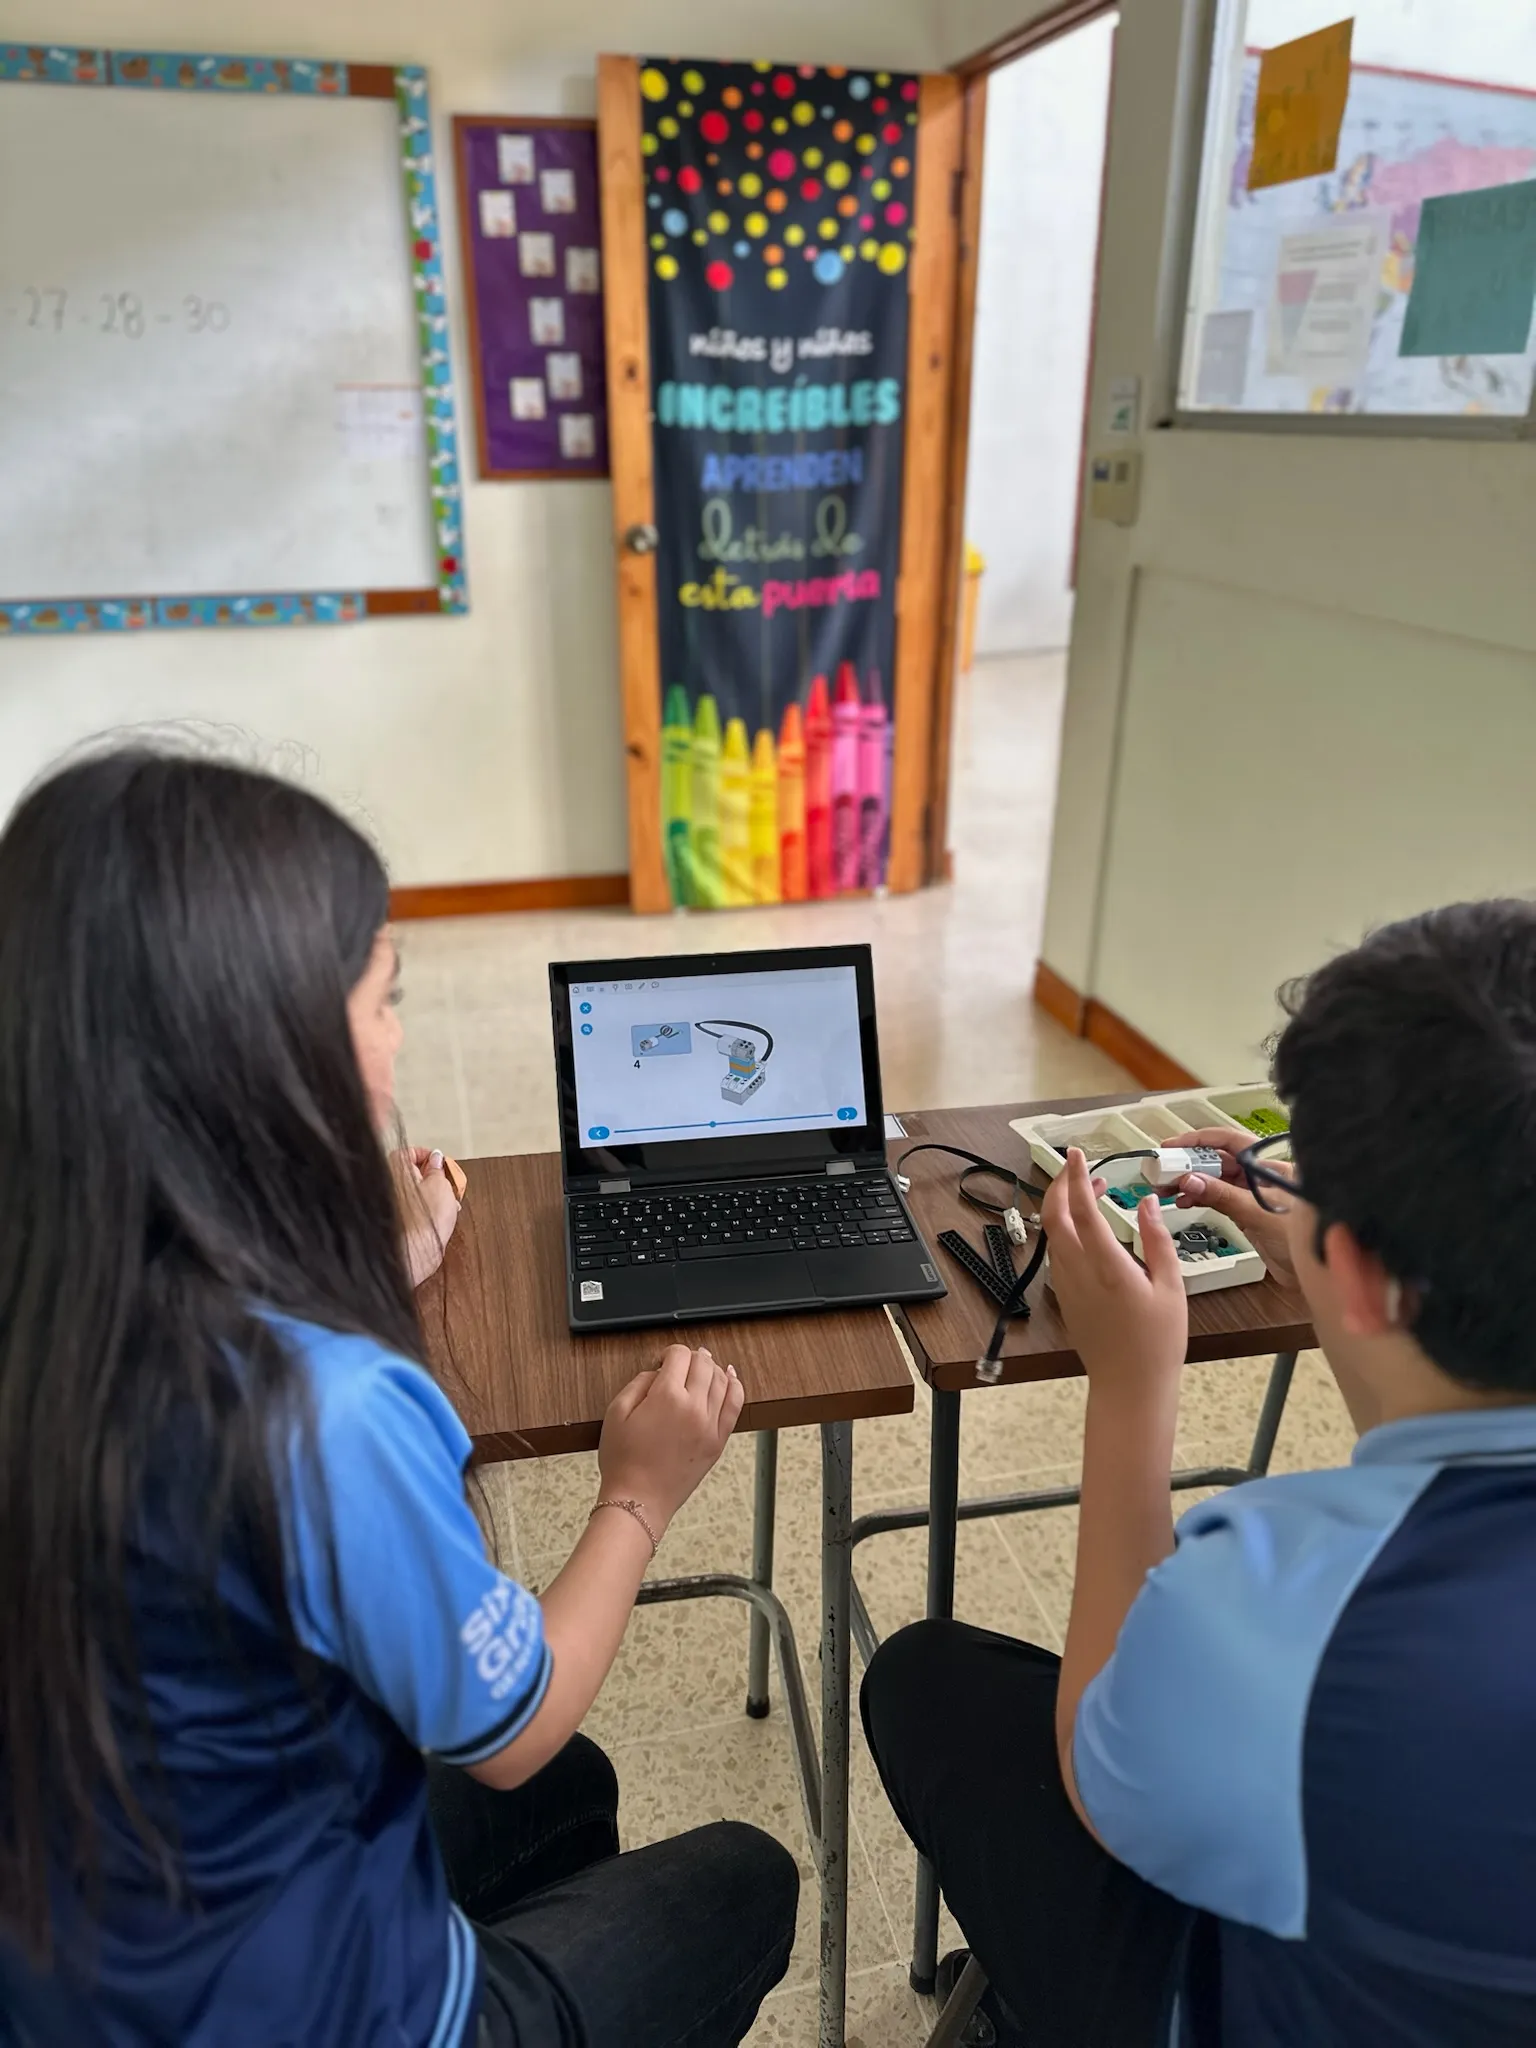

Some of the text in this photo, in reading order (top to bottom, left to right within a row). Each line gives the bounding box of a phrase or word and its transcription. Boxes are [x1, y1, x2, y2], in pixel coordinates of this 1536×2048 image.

[183, 293, 232, 334] 30
[769, 337, 794, 373] y
[657, 375, 900, 434] INCREÍBLES
[701, 448, 863, 491] APRENDEN
[679, 566, 880, 619] esta puerta
[633, 1060, 641, 1069] 4
